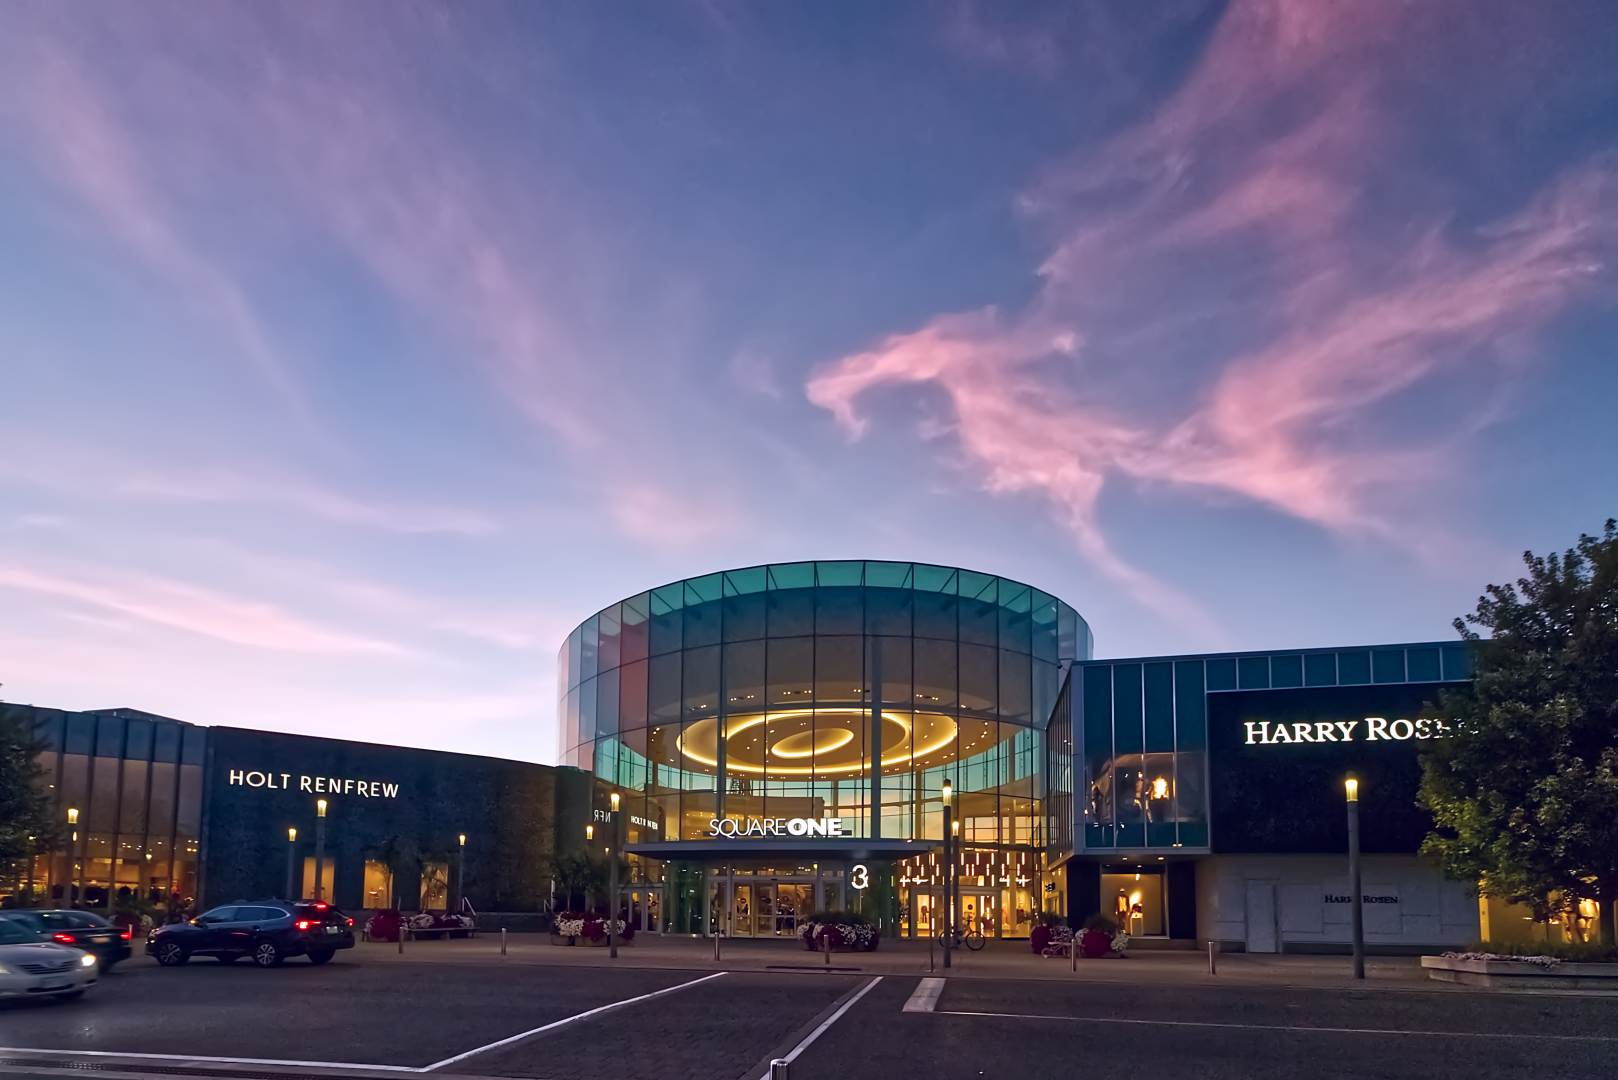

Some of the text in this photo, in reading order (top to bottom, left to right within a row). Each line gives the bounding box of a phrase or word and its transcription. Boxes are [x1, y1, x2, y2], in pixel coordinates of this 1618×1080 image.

[1244, 720, 1358, 744] HARRY
[229, 769, 399, 798] HOLT RENFREW
[851, 864, 869, 890] 3
[1362, 894, 1399, 904] ROSEN
